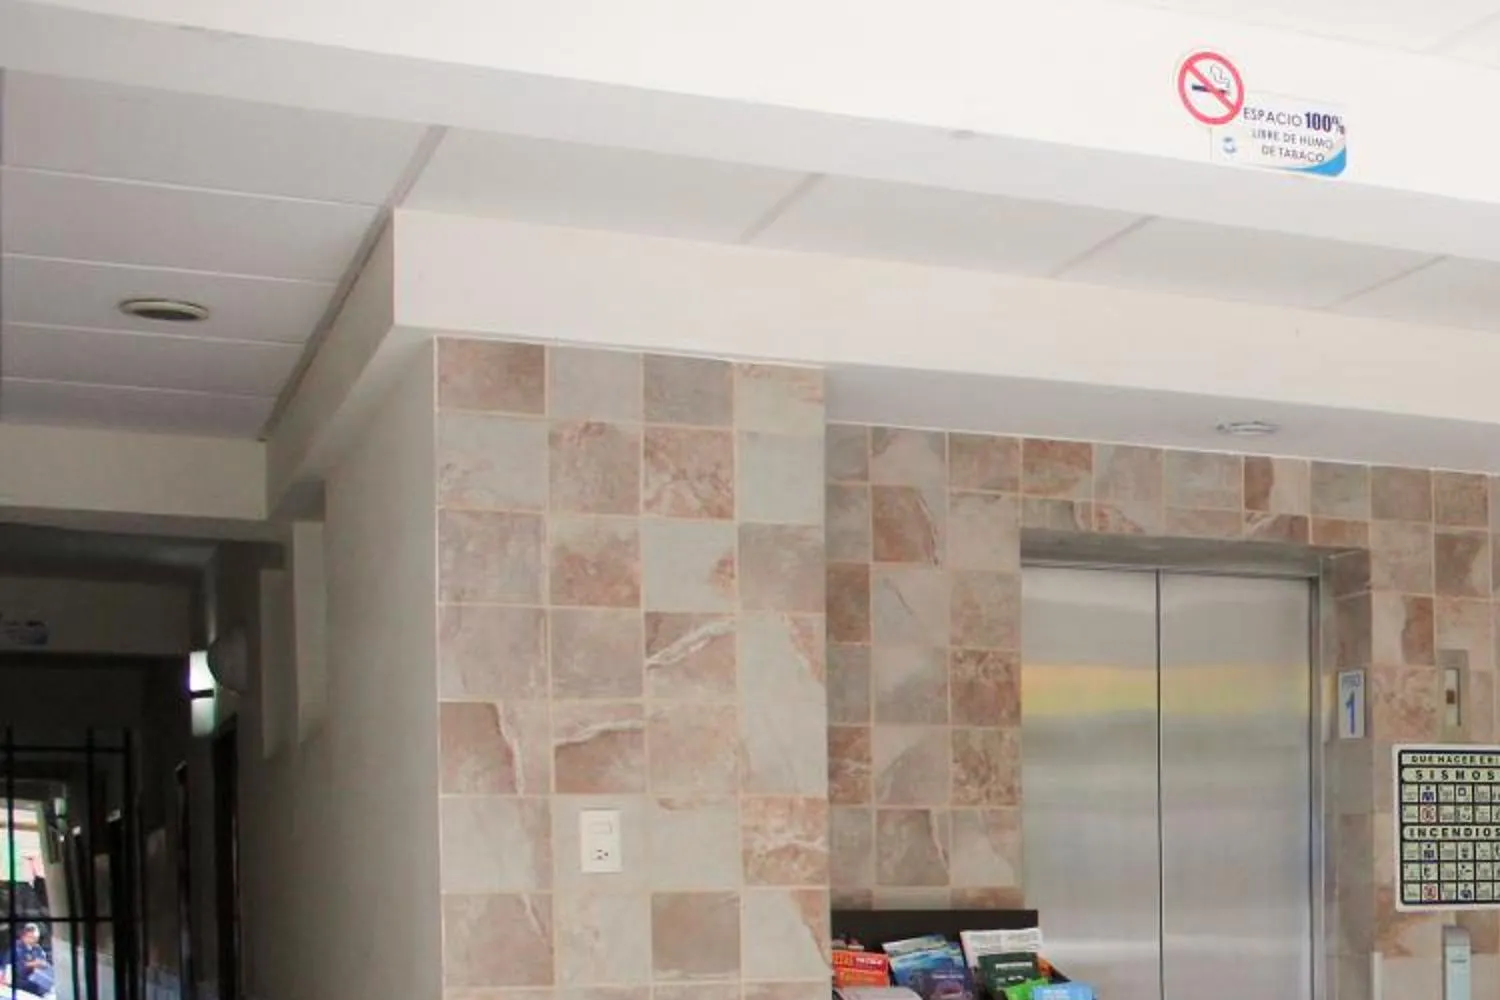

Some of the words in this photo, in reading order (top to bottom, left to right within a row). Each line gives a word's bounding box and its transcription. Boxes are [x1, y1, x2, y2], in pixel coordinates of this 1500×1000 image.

[1243, 107, 1302, 126] ESPACIO
[1304, 111, 1345, 135] 100%
[1252, 128, 1280, 142] LIBRE
[1283, 131, 1298, 144] DE
[1261, 144, 1275, 156] DE
[1279, 146, 1325, 163] TABACO
[1345, 690, 1355, 735] 1
[1416, 770, 1495, 780] SISMOS
